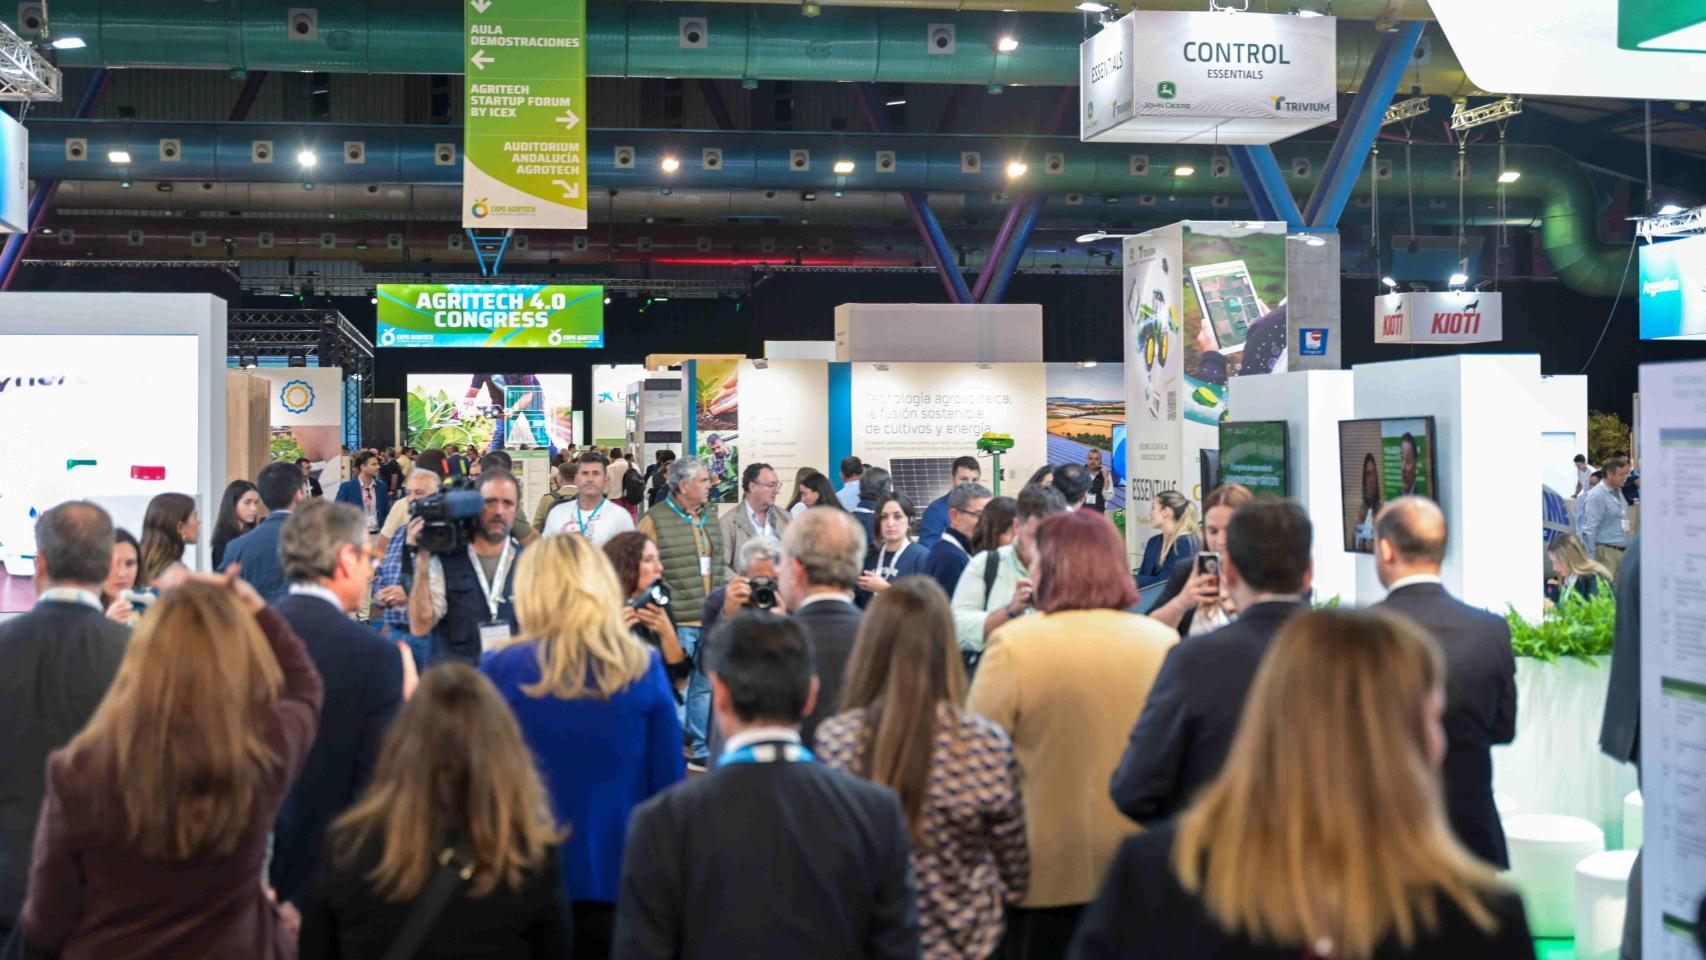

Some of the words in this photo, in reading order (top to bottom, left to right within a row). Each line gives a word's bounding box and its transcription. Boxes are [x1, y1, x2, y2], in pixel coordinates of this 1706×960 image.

[470, 25, 503, 35] AULA
[470, 36, 580, 48] DEMOSTRACIONES
[1183, 41, 1291, 65] CONTROL
[1207, 69, 1264, 80] ESSENTIALS
[470, 84, 530, 95] AGRITECH
[470, 96, 525, 106] STARTUP
[528, 97, 571, 107] FORUM
[1144, 102, 1164, 110] JOHN
[470, 107, 487, 117] BY
[490, 108, 517, 118] ICEX
[1285, 102, 1330, 113] TRIVIUM
[504, 142, 580, 152] AUDITORIUM
[512, 153, 580, 164] ANDALUCÍA
[516, 165, 580, 175] AGROTECH
[415, 292, 524, 310] AGRITECH
[529, 292, 567, 310] 4.0
[434, 311, 550, 329] CONGRESS
[1383, 314, 1404, 336] KIOTI
[1431, 312, 1481, 334] KIOTI
[865, 392, 931, 407] eología
[934, 392, 1013, 407] agrooaica,
[865, 423, 880, 434] de
[884, 423, 932, 434] cultivos
[936, 425, 943, 437] y
[946, 422, 992, 437] energía
